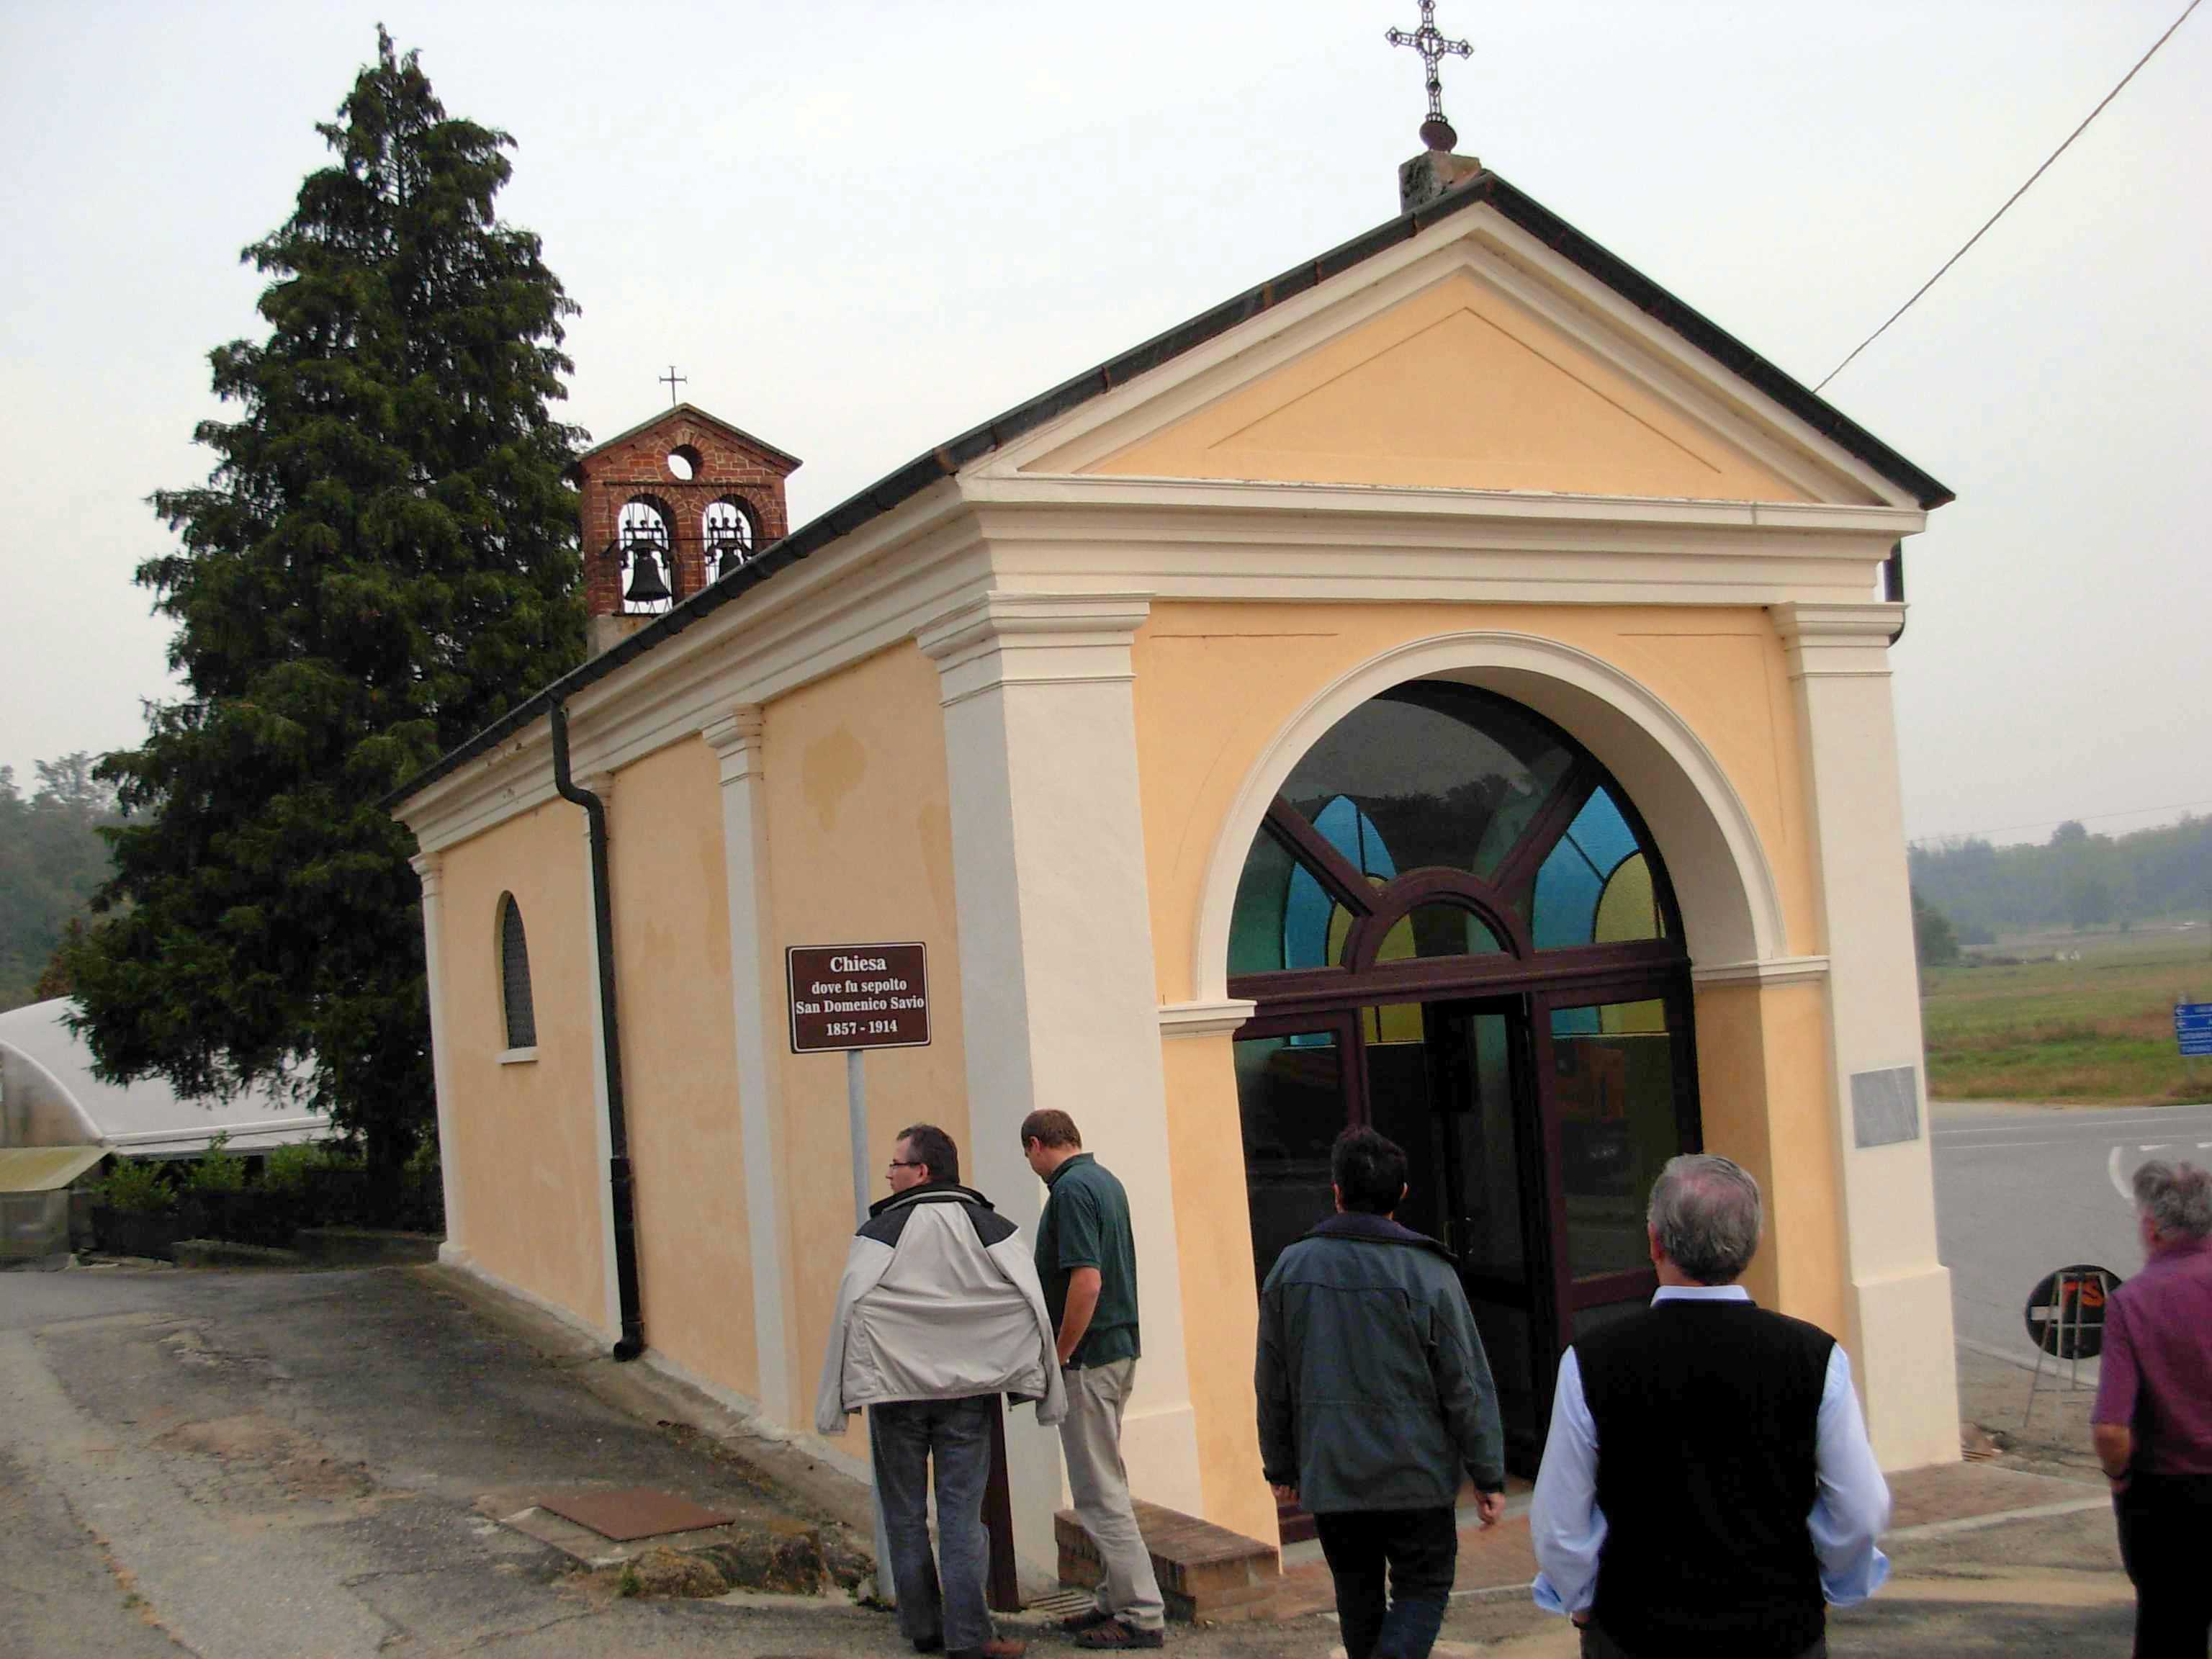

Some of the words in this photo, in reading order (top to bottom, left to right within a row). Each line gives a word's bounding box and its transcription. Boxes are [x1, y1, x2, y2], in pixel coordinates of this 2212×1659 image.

[830, 955, 887, 972] Chiesa
[811, 981, 842, 994] dove
[845, 980, 858, 993] fu
[861, 978, 907, 994] sepolto
[796, 1001, 820, 1015] San
[824, 997, 887, 1012] Domenico
[891, 994, 924, 1010] Savio
[826, 1022, 857, 1036] 1857
[868, 1020, 899, 1034] 1914
